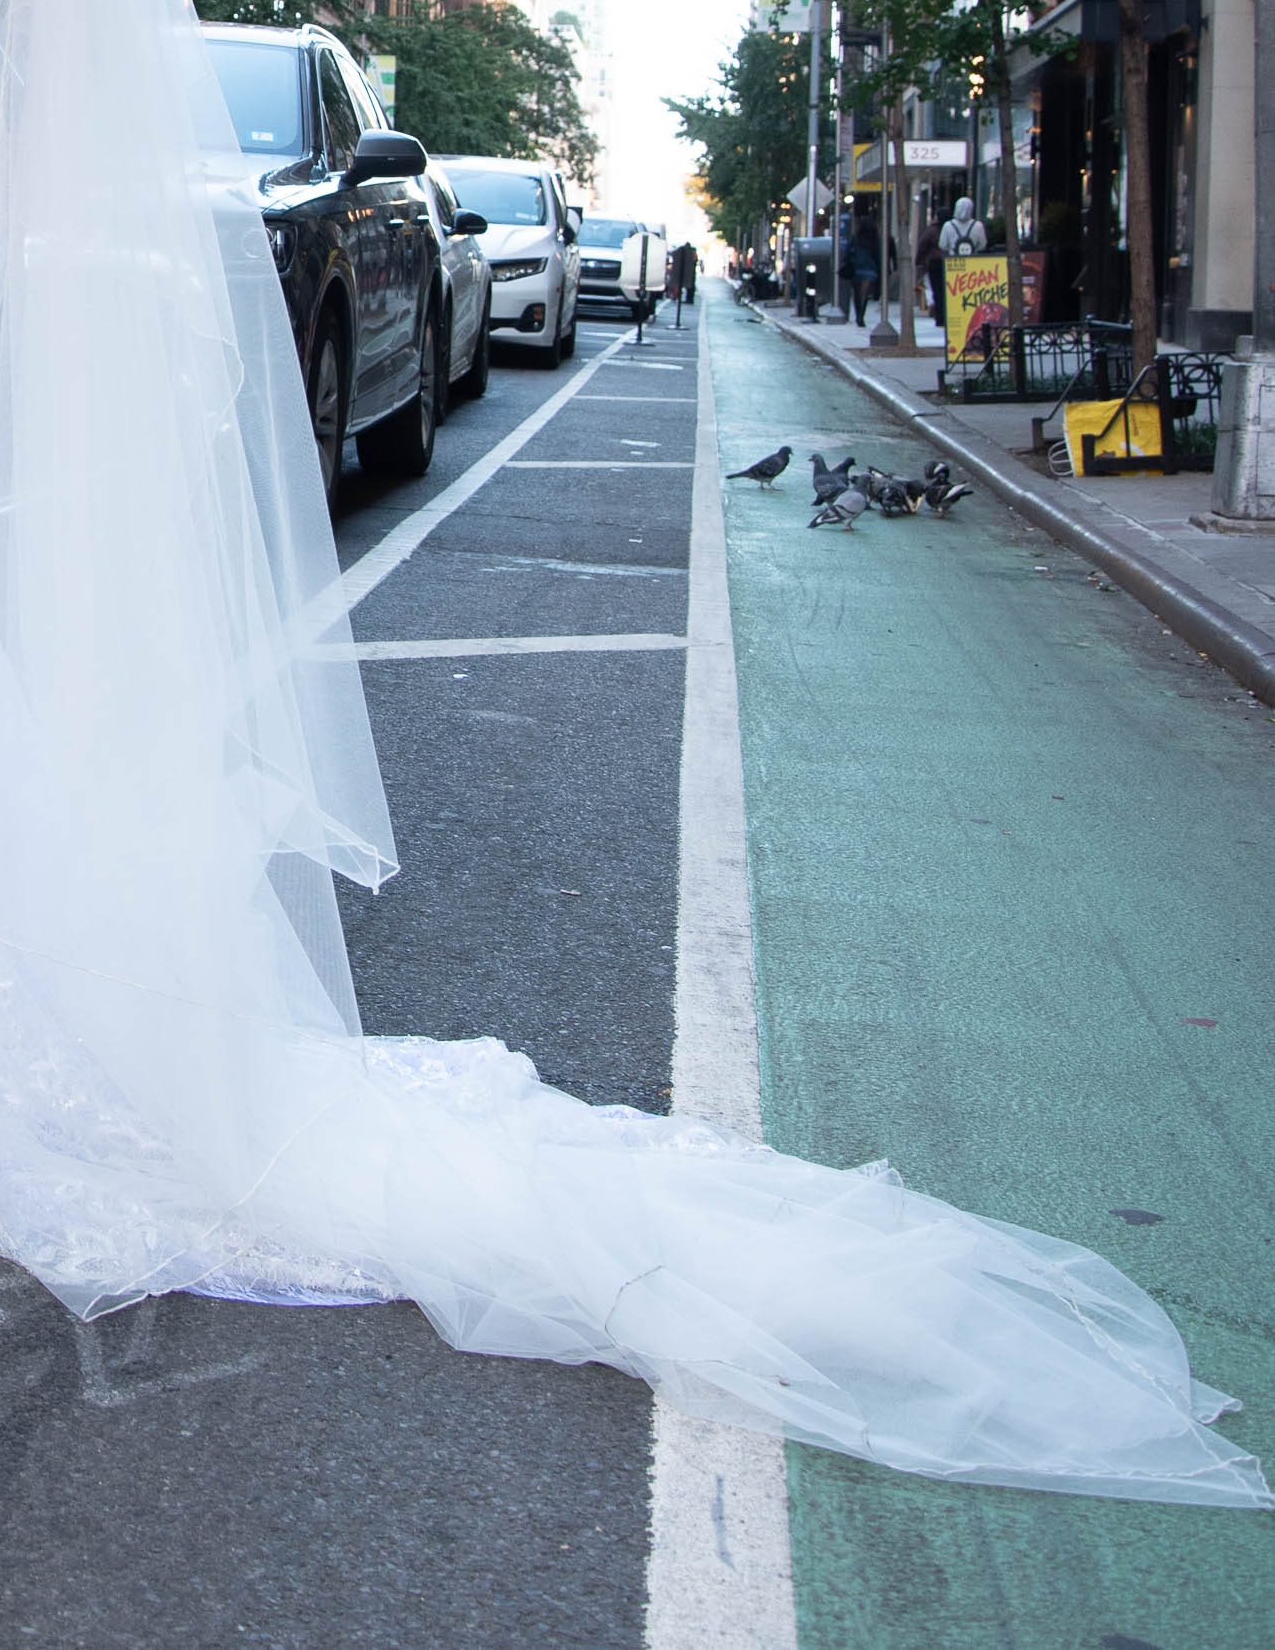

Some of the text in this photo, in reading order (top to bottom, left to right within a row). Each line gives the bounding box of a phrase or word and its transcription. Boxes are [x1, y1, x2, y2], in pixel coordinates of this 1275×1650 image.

[910, 146, 940, 160] 325
[946, 263, 1000, 297] VEGAN
[961, 281, 1010, 312] KITCHE
